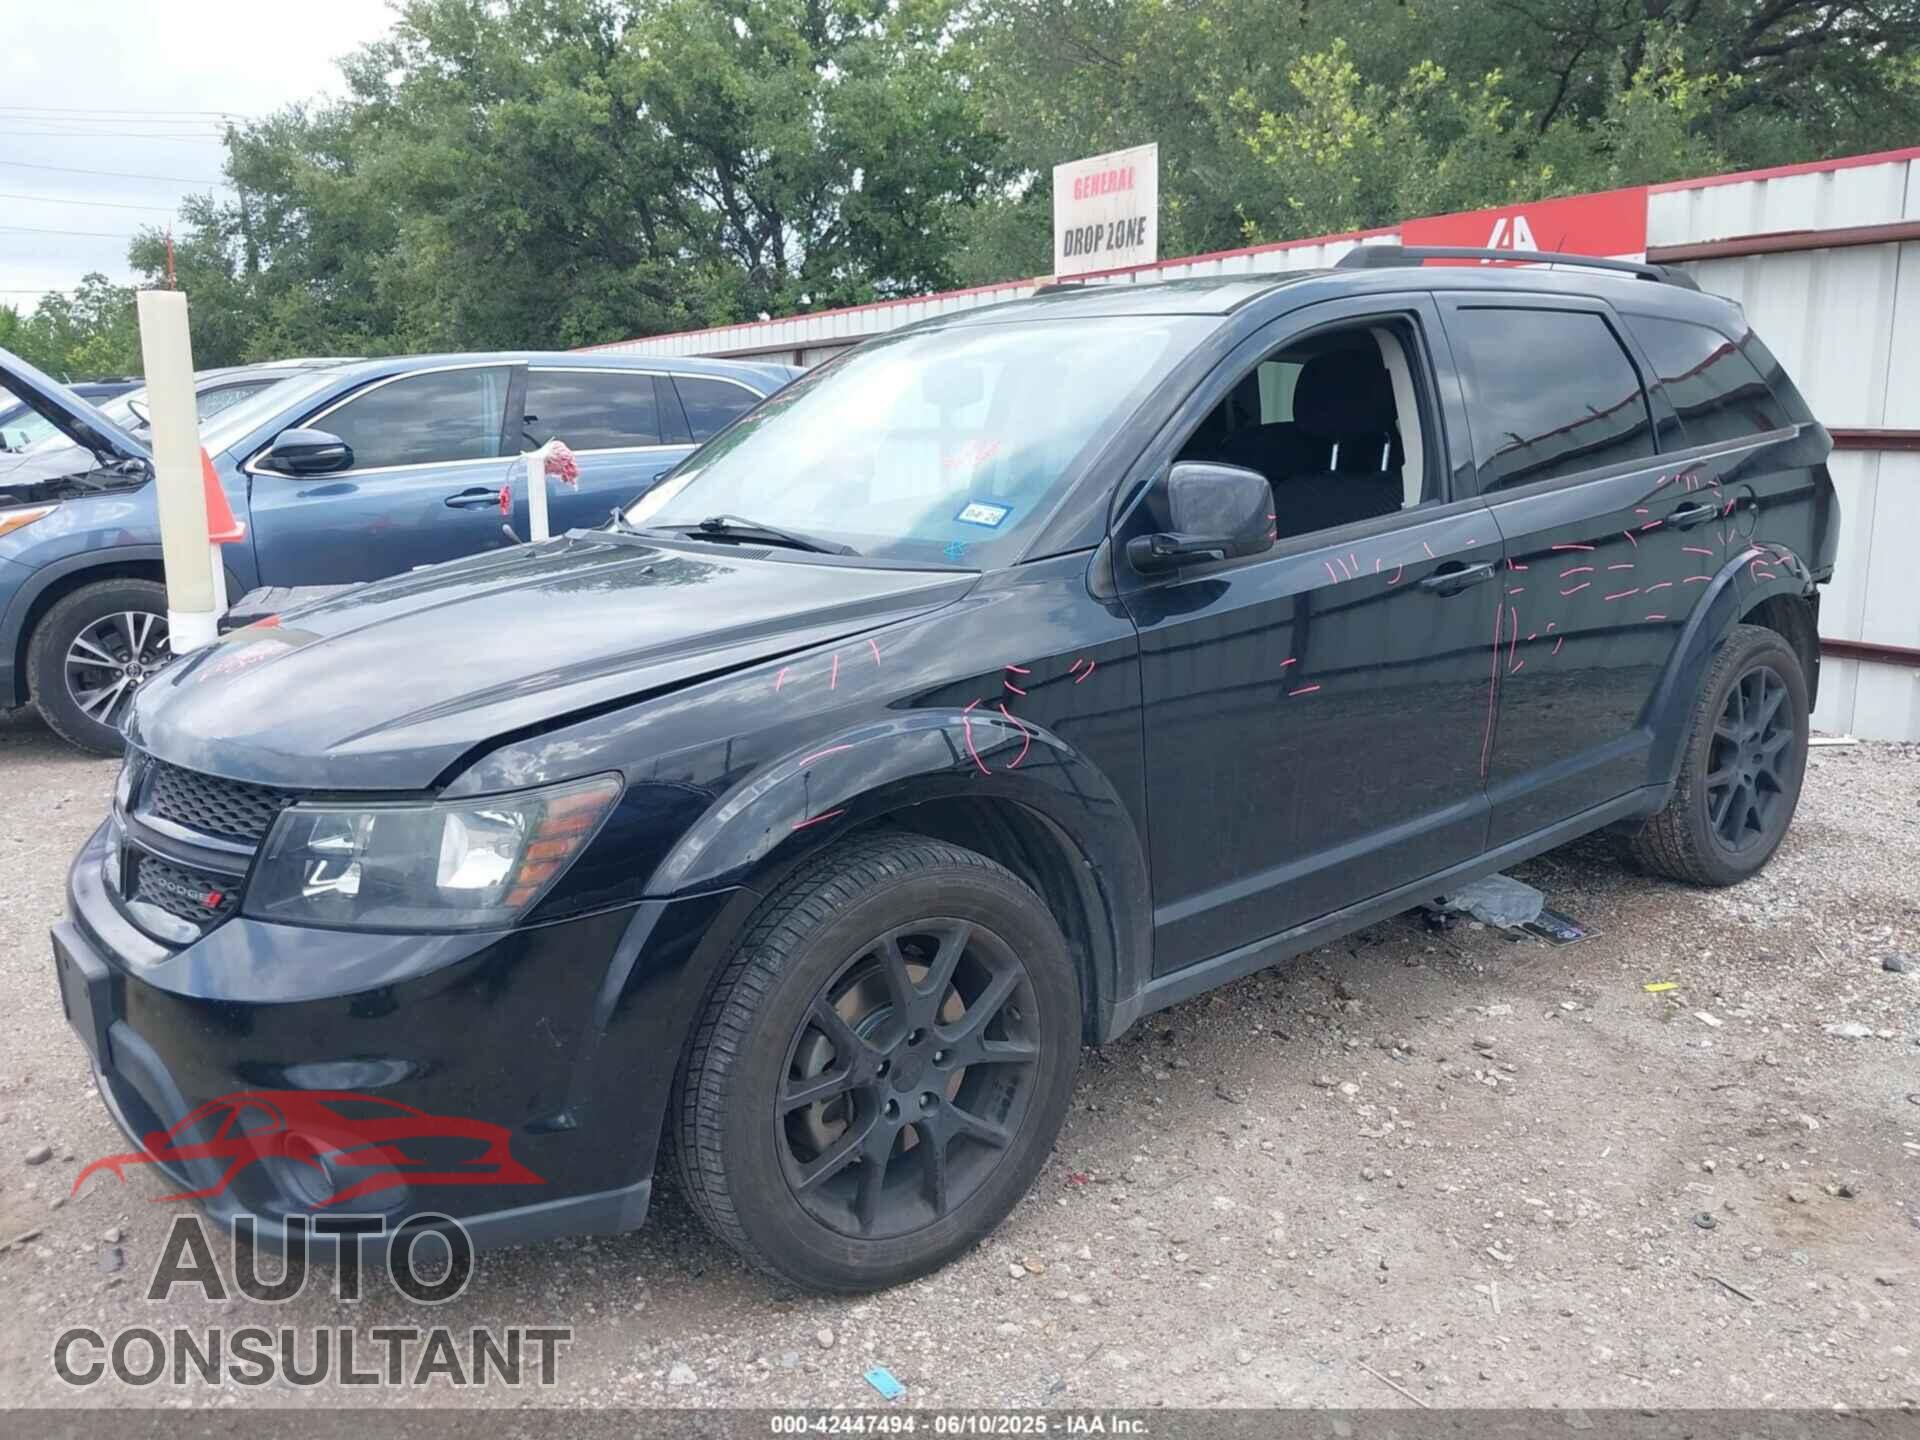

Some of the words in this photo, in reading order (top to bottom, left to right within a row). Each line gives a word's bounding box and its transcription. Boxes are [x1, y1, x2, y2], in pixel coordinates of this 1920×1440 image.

[1073, 167, 1135, 200] GENERAL
[1063, 224, 1104, 258] DROP
[1106, 216, 1147, 250] ZONE
[159, 879, 208, 902] DODGE
